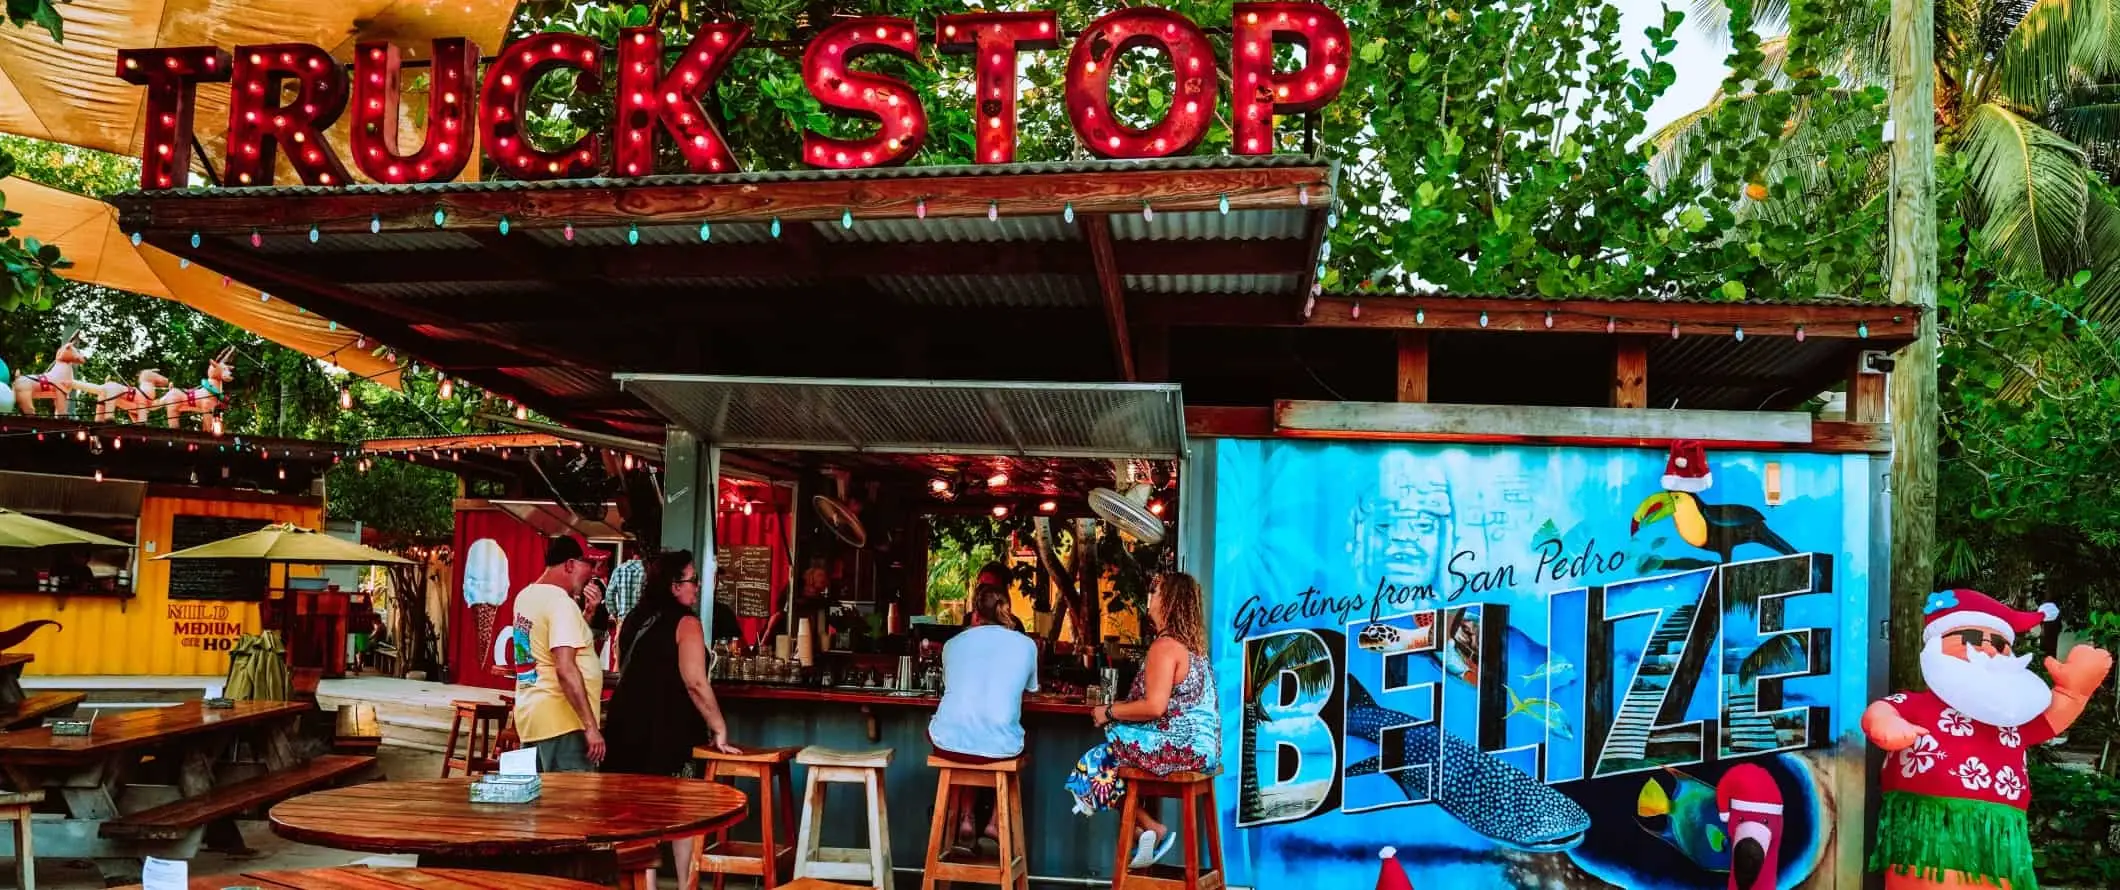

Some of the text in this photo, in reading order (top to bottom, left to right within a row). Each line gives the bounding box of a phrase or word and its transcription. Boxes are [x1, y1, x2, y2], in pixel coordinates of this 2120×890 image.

[117, 1, 1352, 188] TRUCK STOP
[167, 603, 230, 620] MILD
[174, 621, 242, 636] MEDIUM
[1233, 538, 1625, 641] Greetings from San Pedro
[1236, 552, 1834, 829] BELIZE
